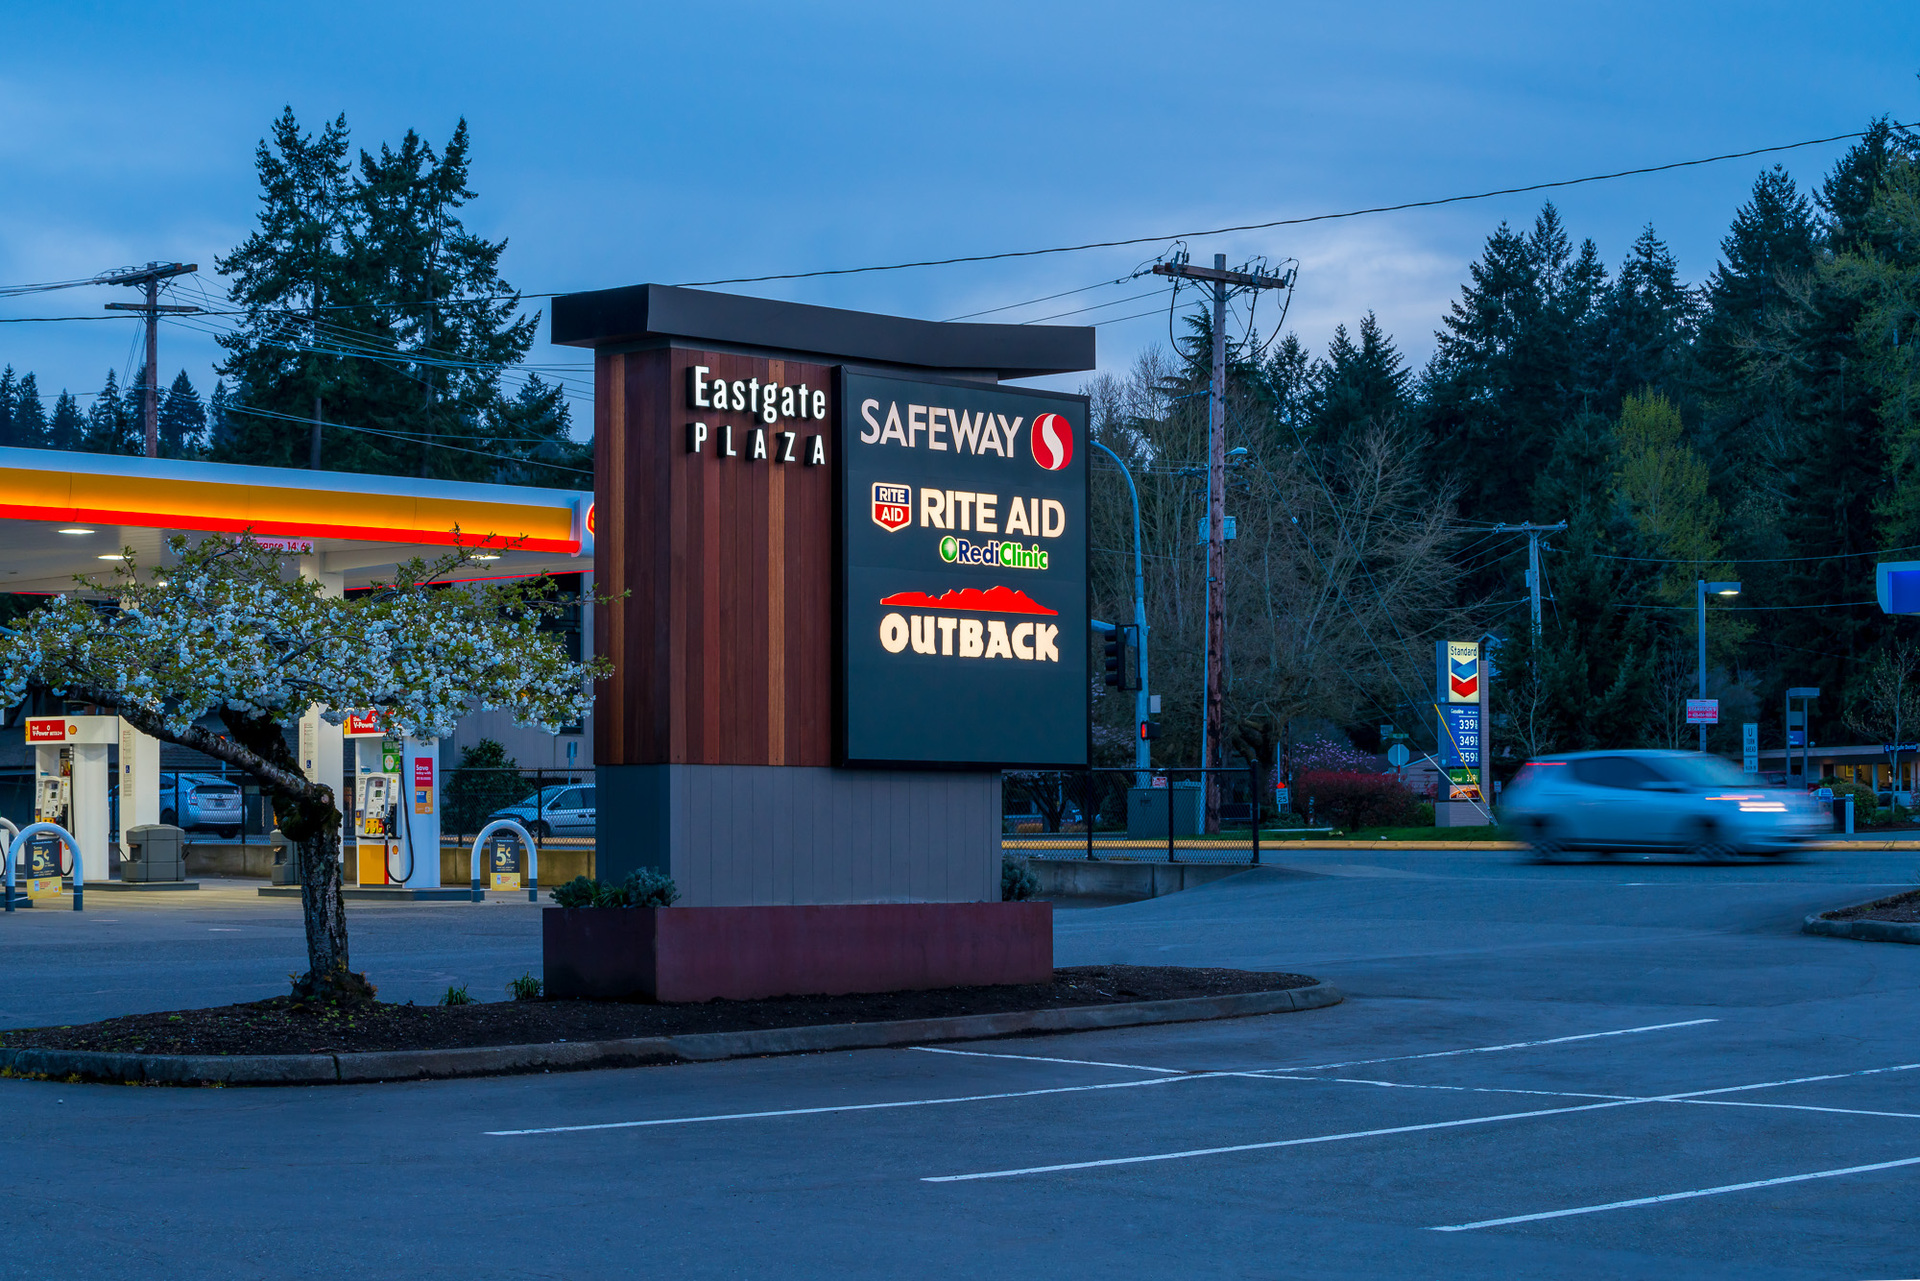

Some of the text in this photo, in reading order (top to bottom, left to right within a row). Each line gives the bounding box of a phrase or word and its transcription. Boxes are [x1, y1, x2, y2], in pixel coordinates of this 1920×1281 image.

[695, 365, 826, 423] Eastgate
[860, 398, 1024, 458] SAFEWAY
[695, 422, 826, 465] PLAZA
[879, 487, 906, 503] RITE
[881, 506, 904, 522] AID
[920, 487, 1066, 538] RITE AID
[957, 539, 1048, 570] RediClinic
[879, 612, 1060, 663] OUTBACK
[1450, 645, 1478, 657] Standard
[1459, 719, 1475, 730] 339
[1747, 727, 1753, 737] U
[1459, 735, 1475, 746] 349
[1459, 752, 1475, 763] 359
